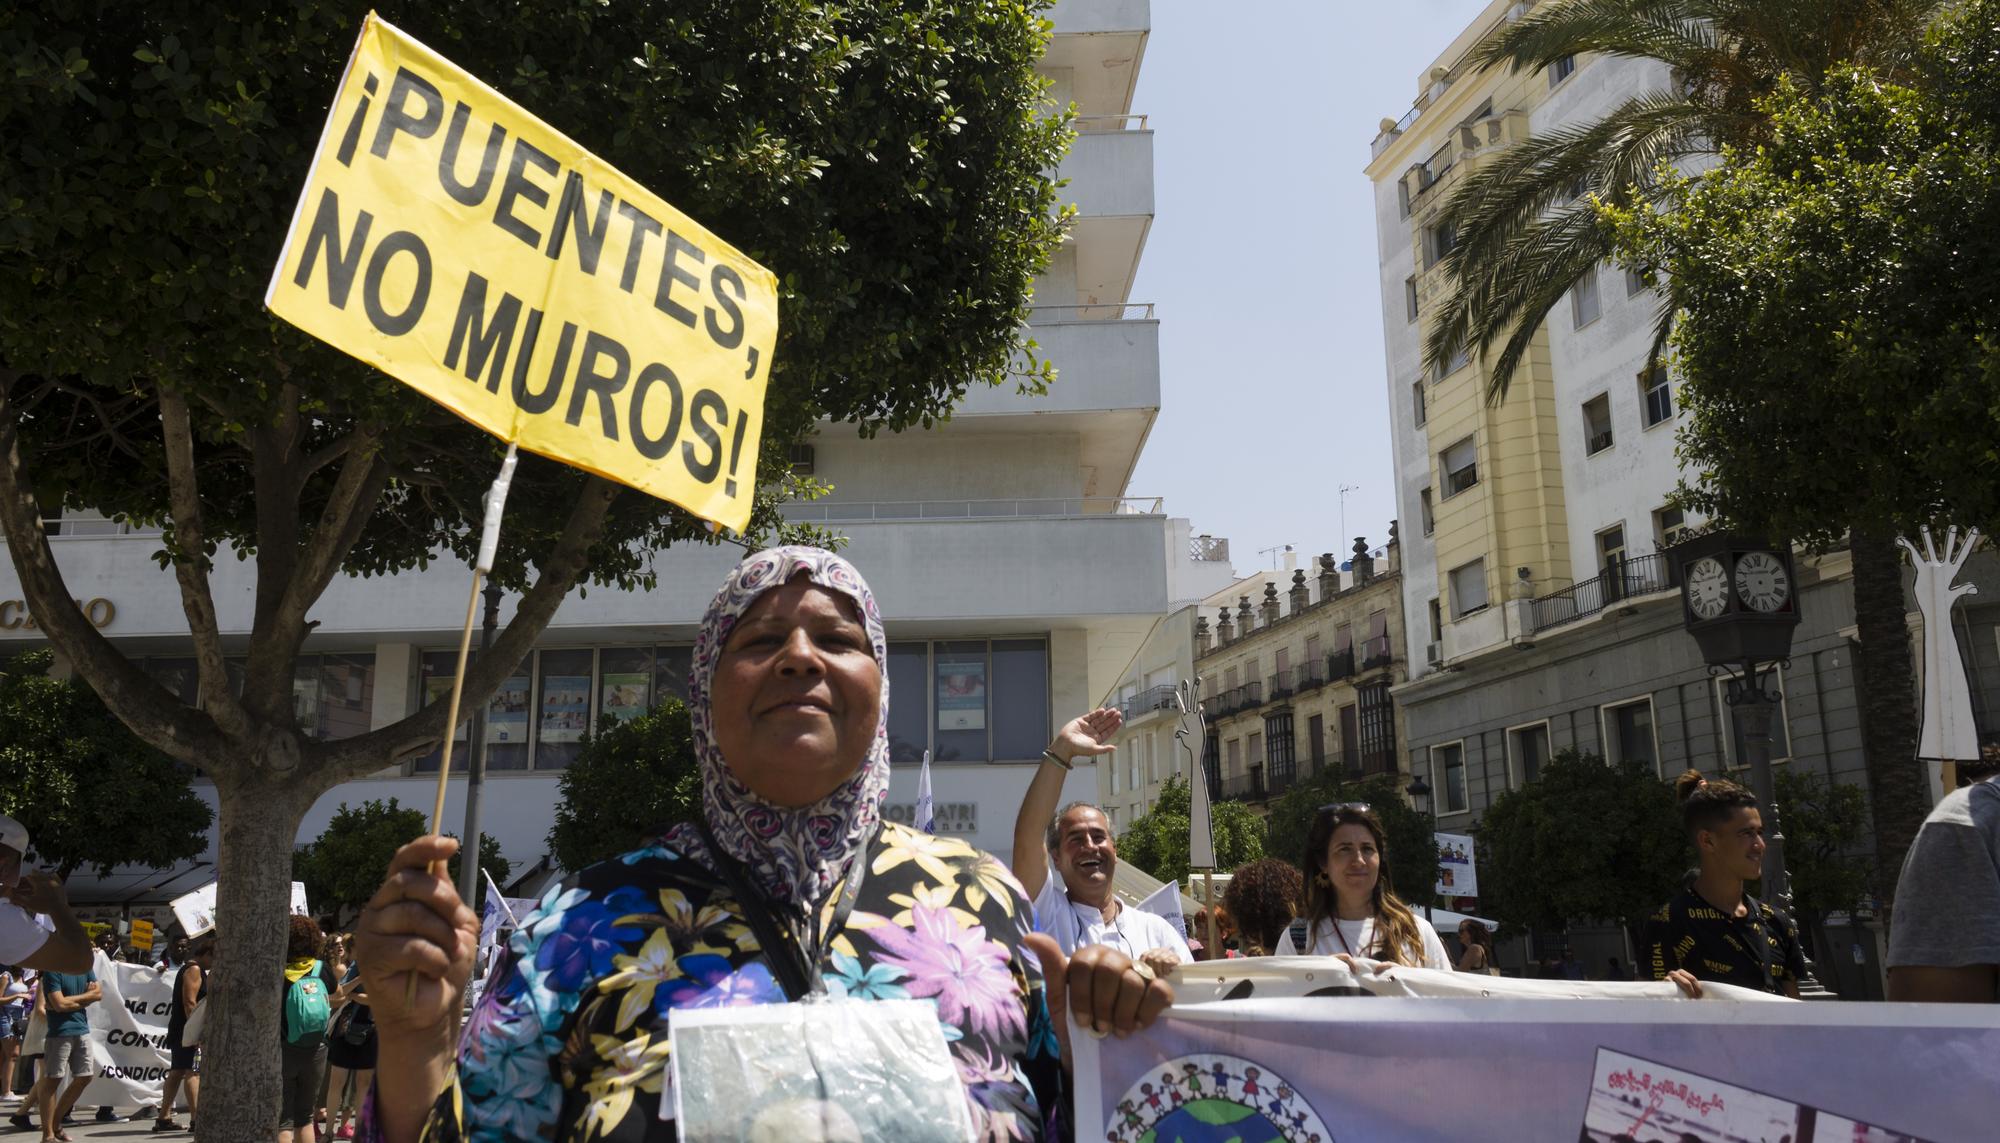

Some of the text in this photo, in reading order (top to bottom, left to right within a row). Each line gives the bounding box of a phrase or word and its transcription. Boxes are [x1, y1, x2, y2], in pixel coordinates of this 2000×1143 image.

[293, 187, 749, 499] NO MUROS!
[335, 66, 760, 381] ¡PUENTES,
[106, 1028, 150, 1048] CON
